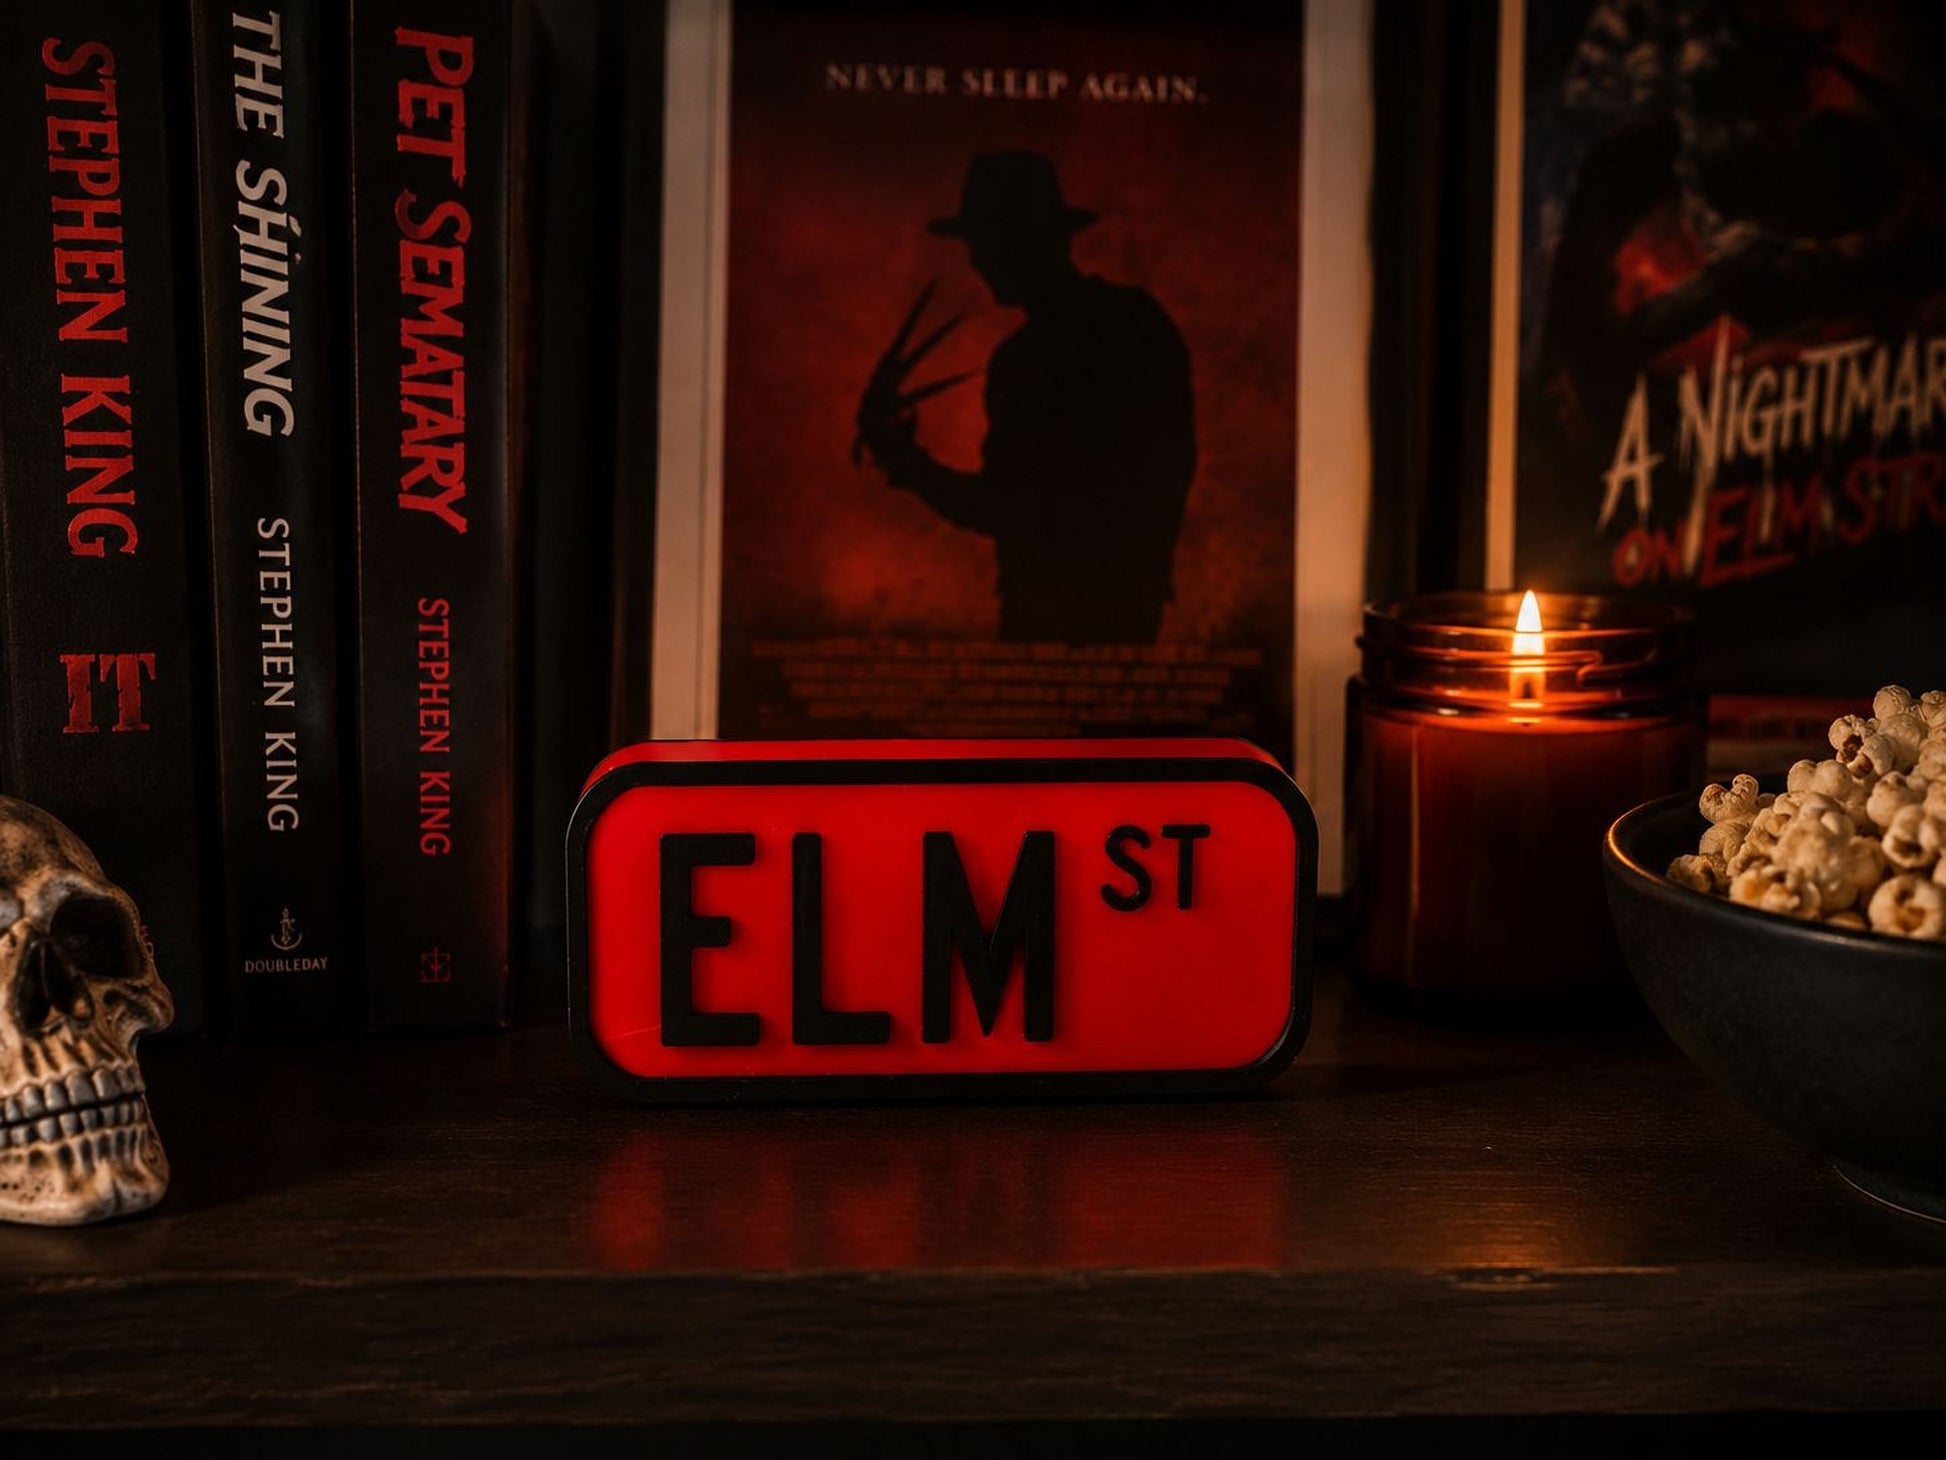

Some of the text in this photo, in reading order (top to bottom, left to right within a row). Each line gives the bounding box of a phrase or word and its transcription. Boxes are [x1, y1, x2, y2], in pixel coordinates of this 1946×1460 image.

[825, 61, 1208, 105] NEVER SLEEP AGAIN.
[40, 36, 140, 559] STEPHEN KING
[231, 11, 303, 439] THE SHINING
[394, 26, 476, 536] PET SEMATARY
[1598, 370, 1664, 534] A
[1612, 518, 1694, 588] ON
[1697, 470, 1822, 588] ELM
[58, 651, 158, 736] IT
[257, 516, 300, 834] STEPHEN KING
[416, 596, 452, 858] STEPHEN KING
[244, 956, 329, 974] DOUBLEDAY
[660, 824, 1211, 1048] ELM ST
